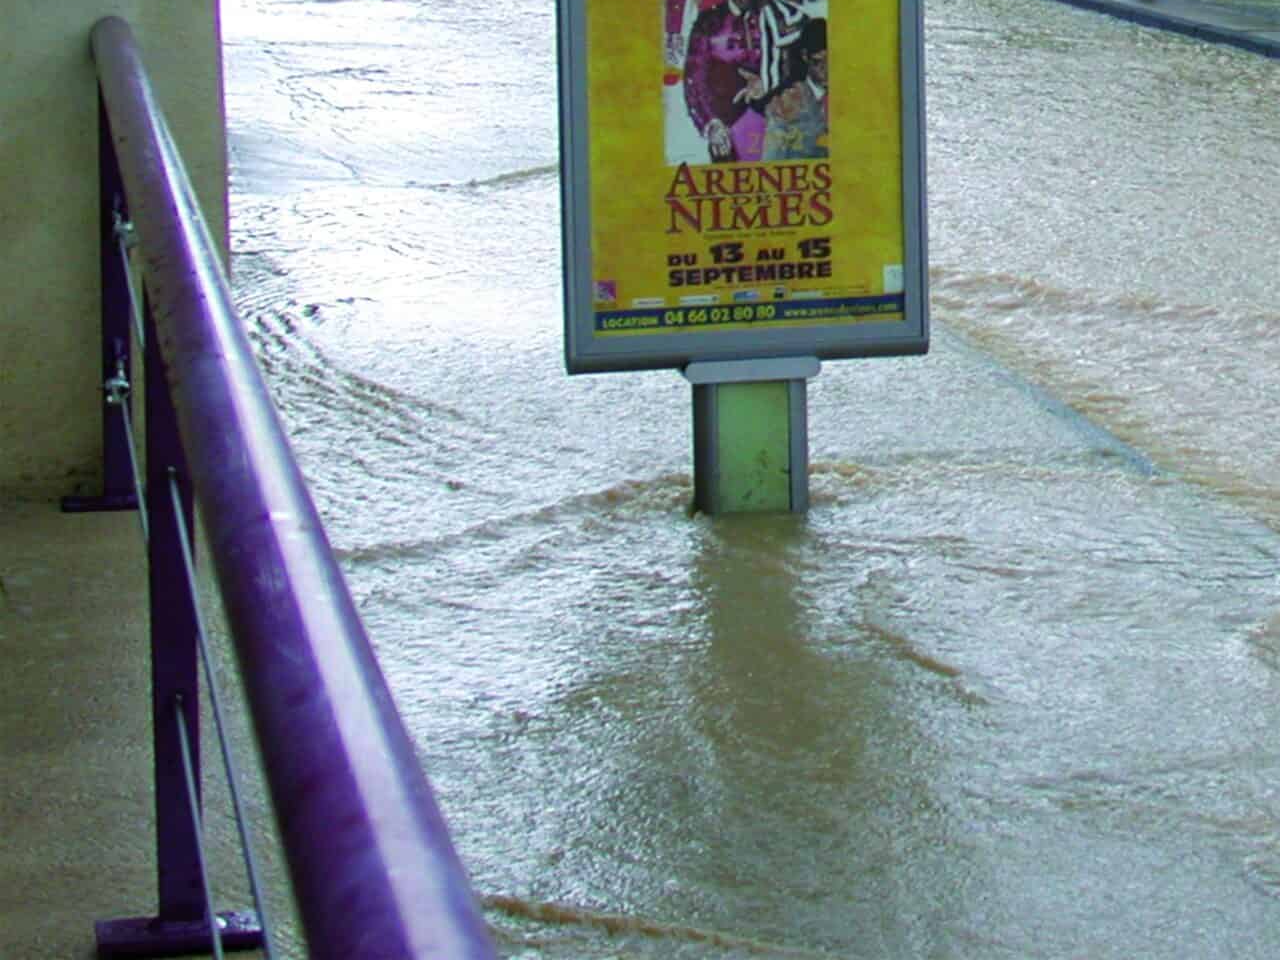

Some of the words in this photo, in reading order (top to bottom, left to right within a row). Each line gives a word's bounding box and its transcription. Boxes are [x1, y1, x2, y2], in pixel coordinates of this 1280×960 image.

[665, 161, 833, 198] ARENES
[665, 192, 834, 234] NIMES
[667, 253, 697, 266] DU
[709, 242, 744, 263] 13
[757, 248, 785, 261] AU
[797, 237, 831, 259] 15
[668, 261, 832, 287] SEPTEMBRE
[603, 316, 658, 328] LOCATION
[665, 310, 684, 324] 04
[688, 309, 707, 323] 66
[734, 306, 753, 320] 80
[756, 304, 775, 319] 80
